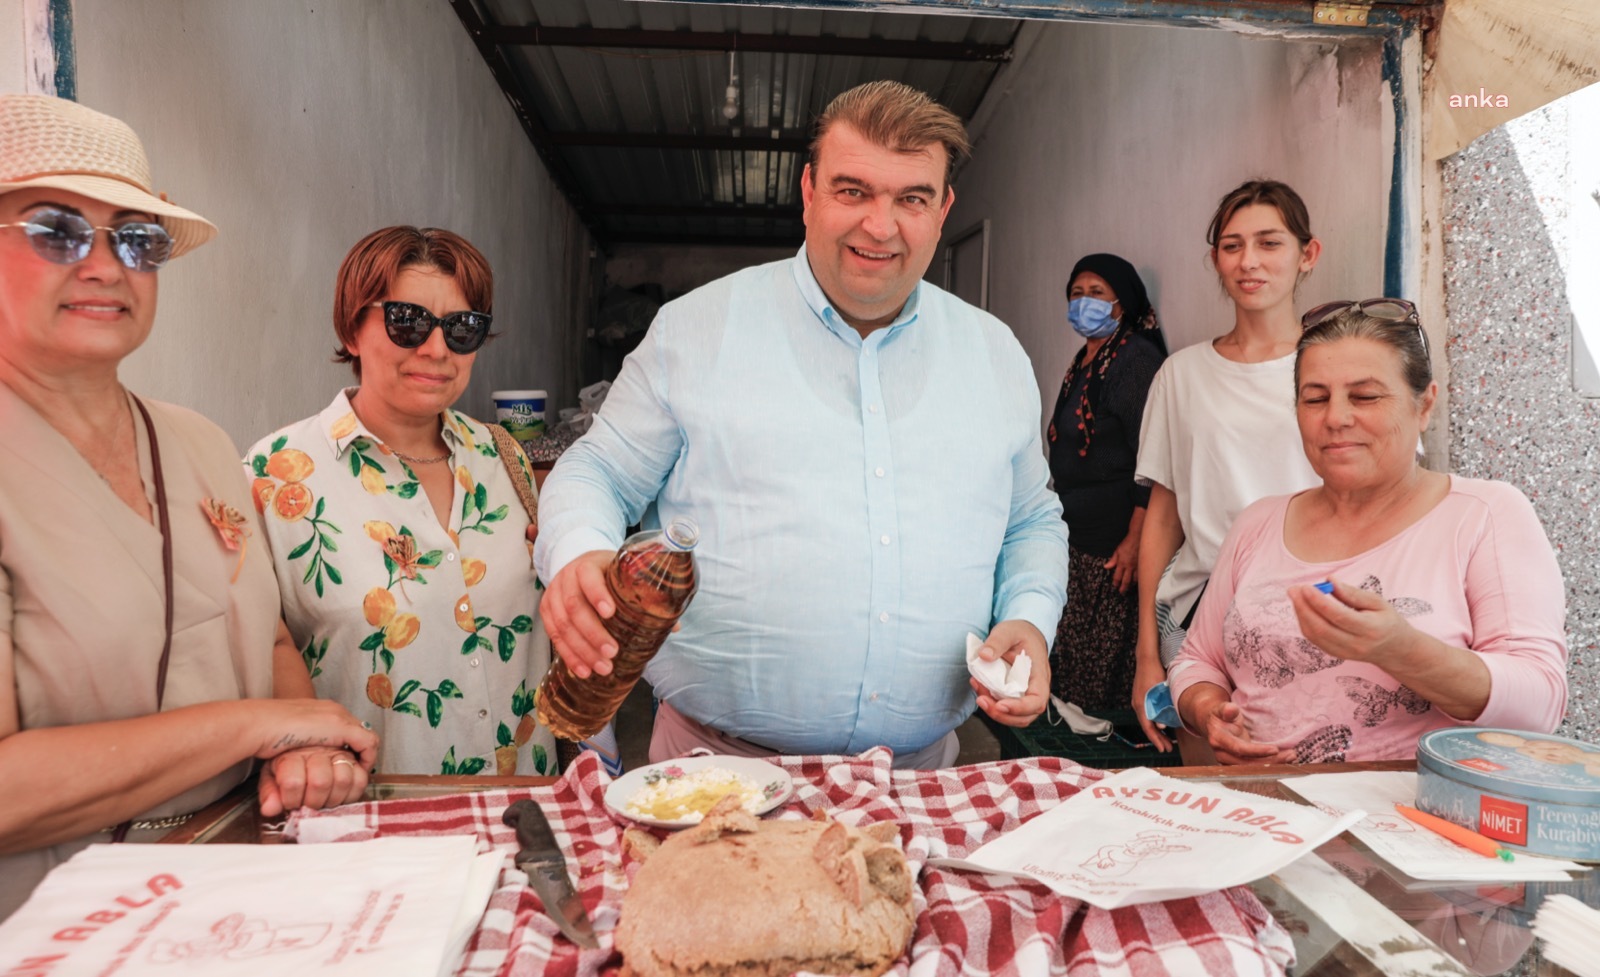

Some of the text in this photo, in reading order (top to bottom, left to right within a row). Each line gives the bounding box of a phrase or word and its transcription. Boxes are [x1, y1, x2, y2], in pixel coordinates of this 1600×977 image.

[1092, 786, 1304, 845] AYSUN ABLA
[1482, 810, 1523, 834] NİMET
[52, 873, 184, 941] ABLA
